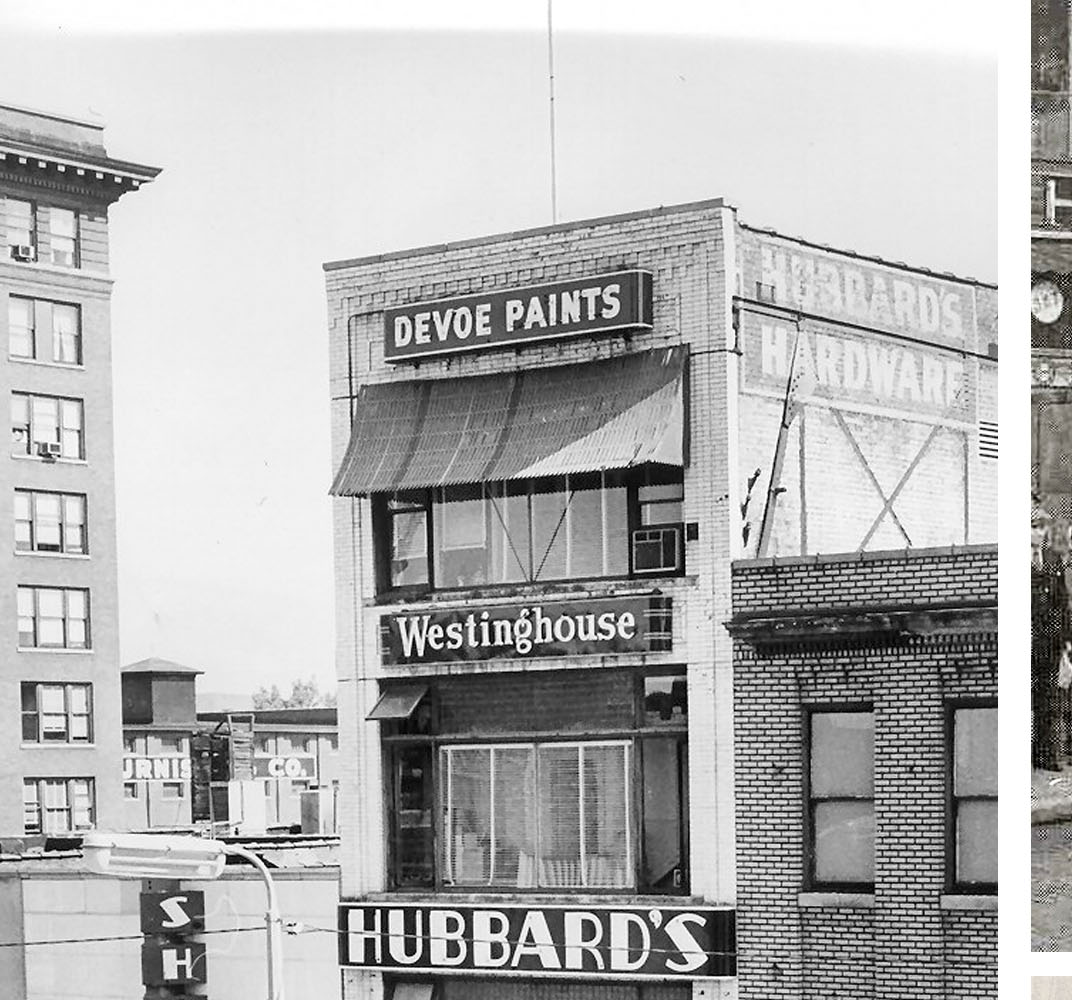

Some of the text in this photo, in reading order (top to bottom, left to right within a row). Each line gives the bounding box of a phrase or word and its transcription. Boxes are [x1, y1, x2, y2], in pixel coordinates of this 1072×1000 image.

[394, 284, 621, 347] DEVOE PAINTS
[393, 606, 636, 658] Westinghouse
[268, 759, 307, 778] CO.
[347, 908, 709, 973] HUBBARD'S
